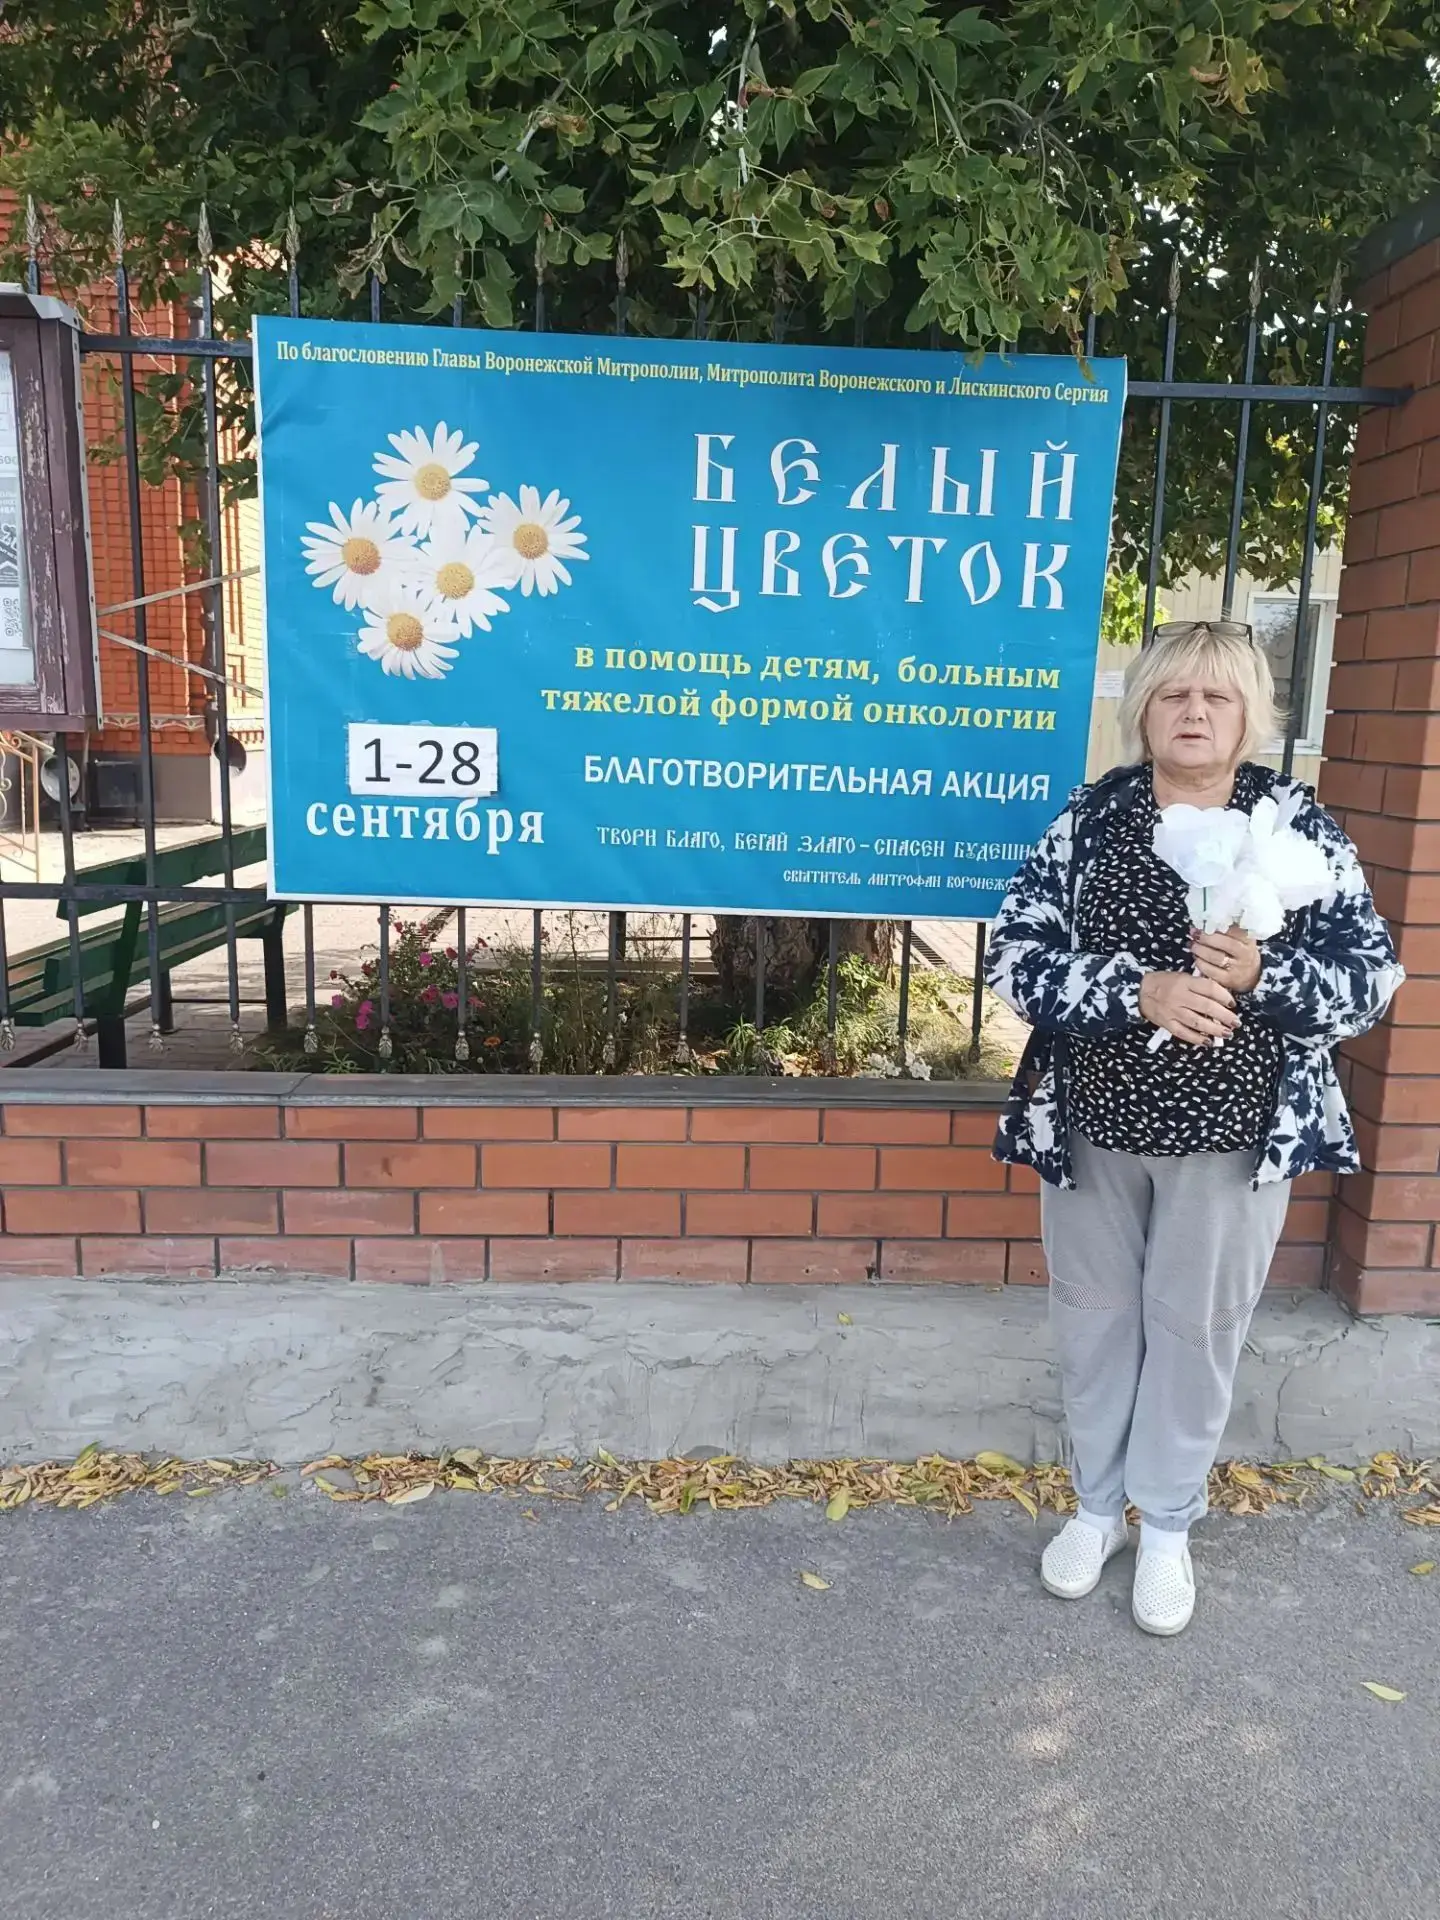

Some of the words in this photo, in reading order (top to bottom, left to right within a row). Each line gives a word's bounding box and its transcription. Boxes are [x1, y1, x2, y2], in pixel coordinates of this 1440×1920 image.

[276, 340, 299, 360] По
[301, 341, 429, 367] благословению
[432, 348, 481, 369] Главы
[485, 351, 593, 376] Воронежской
[597, 357, 702, 383] Митрополии,
[707, 363, 815, 388] Митрополита
[819, 369, 932, 394] Воронежского
[935, 380, 946, 395] и
[948, 376, 1051, 400] Лискинского
[1054, 382, 1109, 406] Сергия
[692, 433, 1080, 521] БЕЛЫЙ
[690, 525, 1071, 613] ЦВЕТОК
[575, 647, 594, 668] в
[605, 648, 752, 680] помощь
[760, 656, 880, 685] детям,
[898, 655, 1061, 689] больным
[541, 687, 701, 716] тяжелой
[710, 689, 853, 726] формой
[863, 702, 1057, 731] онкологии
[363, 737, 482, 786] 1-28
[584, 755, 932, 796] БЛАГОТВОРИТЕЛЬНАЯ
[941, 771, 1051, 804] АКЦИЯ
[306, 797, 545, 855] сентября
[666, 829, 725, 852] БЛАГО,
[735, 831, 788, 852] БЕГАЙ
